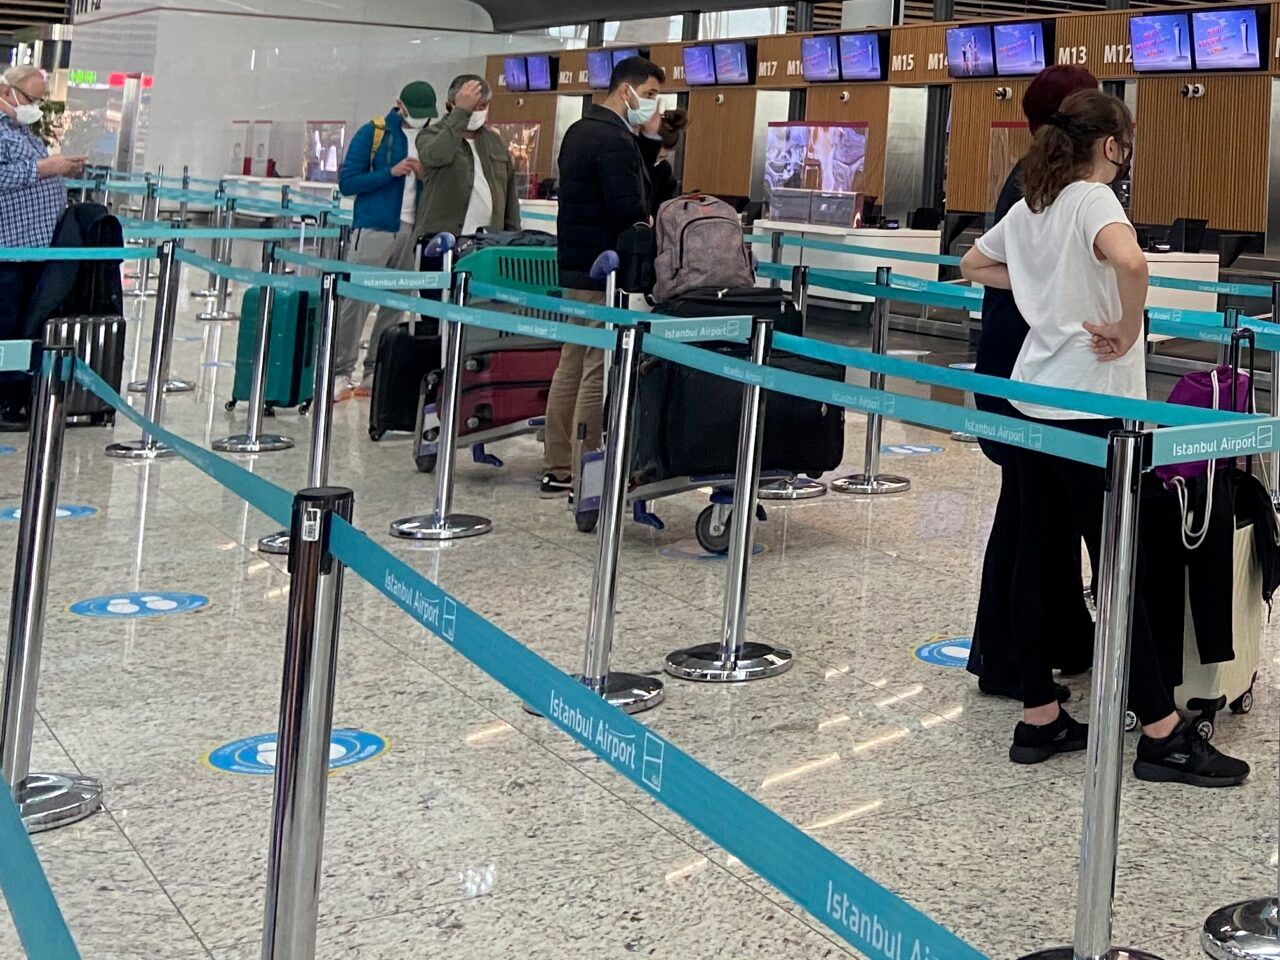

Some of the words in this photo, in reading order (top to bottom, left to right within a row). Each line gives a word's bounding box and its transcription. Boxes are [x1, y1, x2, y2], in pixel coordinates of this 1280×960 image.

[891, 53, 914, 72] M15
[1058, 46, 1087, 65] M13
[1103, 43, 1133, 64] M12
[758, 61, 778, 77] M17
[664, 326, 698, 340] Istanbul
[699, 323, 728, 338] Airport
[964, 418, 997, 437] Istanbul
[997, 424, 1025, 444] Airport
[1172, 439, 1218, 457] Istanbul
[1220, 435, 1257, 452] Airport
[385, 568, 414, 608] Istanbul
[413, 589, 440, 627] Airport
[549, 688, 594, 741] Istanbul
[595, 719, 637, 770] Airport
[826, 879, 902, 960] Istanbul
